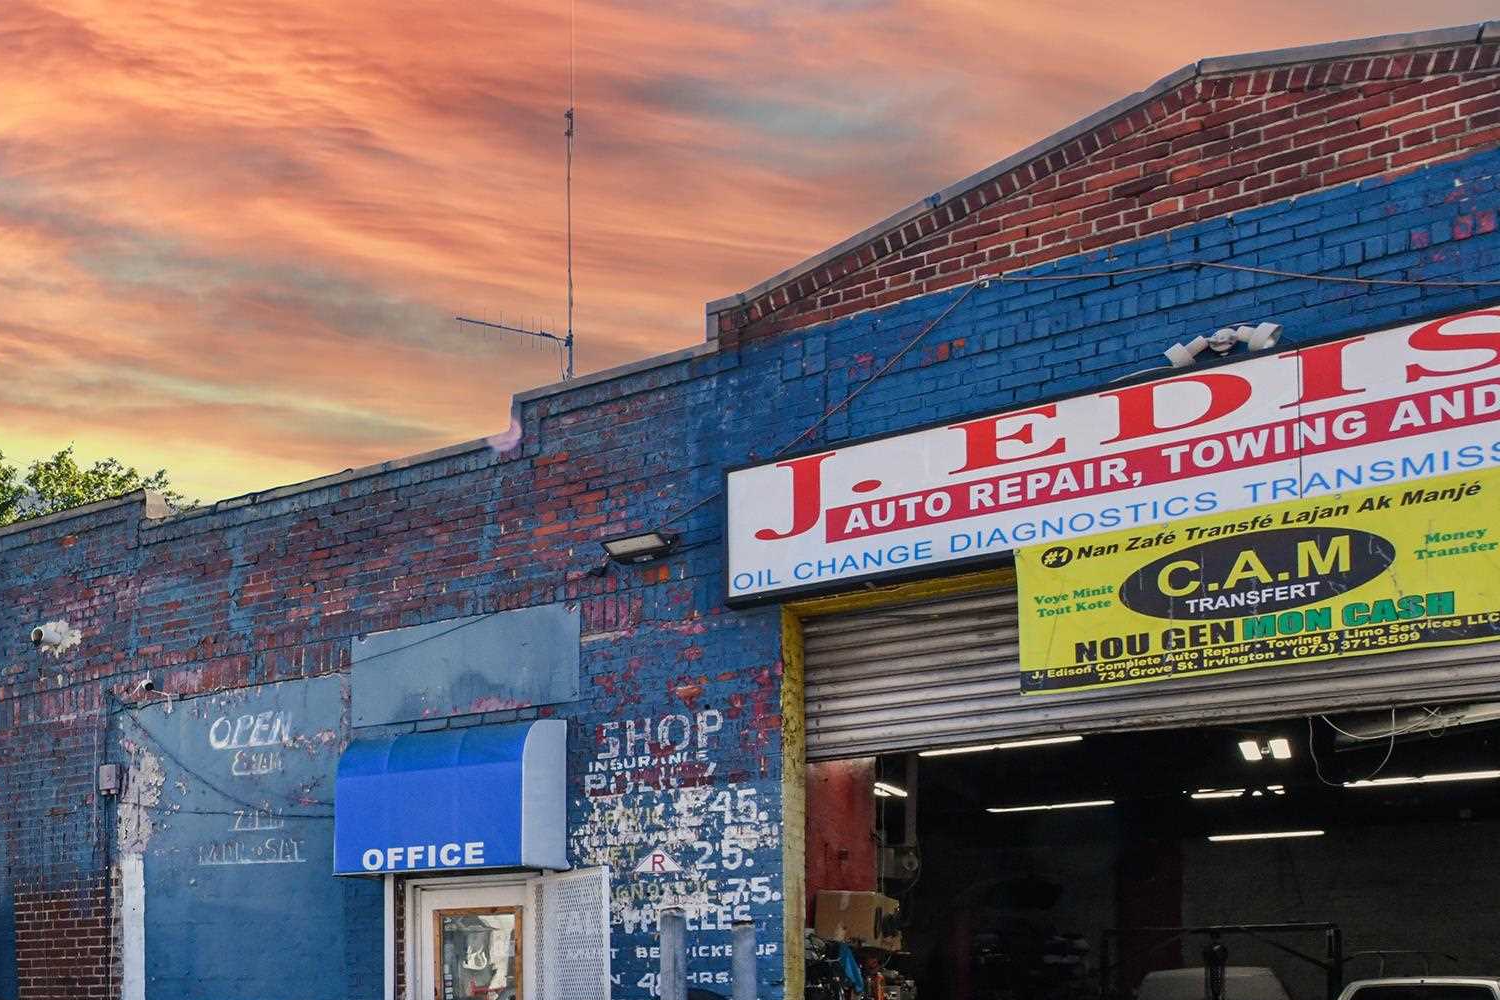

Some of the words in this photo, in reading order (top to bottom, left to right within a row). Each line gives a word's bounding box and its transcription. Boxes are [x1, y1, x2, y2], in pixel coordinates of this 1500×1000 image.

[844, 491, 952, 534] AUTO
[969, 457, 1142, 511] REPAIR,
[1162, 411, 1367, 474] TOWING
[1389, 381, 1500, 432] AND
[1077, 543, 1118, 560] Nan
[1124, 531, 1176, 550] Zafé
[1185, 512, 1273, 541] Transfé
[1281, 503, 1349, 524] Lajan
[1357, 496, 1393, 513] Ak
[1399, 480, 1482, 506] Manjé
[1426, 528, 1488, 545] Money
[733, 568, 781, 590] OIL
[794, 540, 933, 581] CHANGE
[950, 491, 1218, 553] DIAGNOSTICS
[1414, 541, 1499, 560] Transfer
[1157, 534, 1351, 597] C.A.M
[1034, 593, 1069, 606] Voye
[1073, 584, 1114, 598] Minit
[1037, 606, 1071, 618] Tout
[1076, 599, 1112, 613] Kote
[1185, 581, 1321, 613] TRANSFERT
[1075, 633, 1149, 663] NOU
[1161, 621, 1235, 650] GEN
[1243, 606, 1332, 640] MON
[1341, 591, 1455, 627] CASH
[1047, 665, 1091, 679] Edison
[1096, 655, 1161, 672] Complete
[1166, 650, 1198, 664] Auto
[1203, 644, 1251, 659] Repair
[1267, 634, 1322, 650] Towing
[1330, 631, 1340, 641] &
[1344, 626, 1384, 639] Limo
[1389, 618, 1461, 633] Services
[1098, 671, 1125, 682] 734
[1130, 665, 1173, 678] Grove
[1177, 661, 1198, 671] St.
[1203, 650, 1275, 668] Irvington
[1292, 642, 1336, 658] (973)
[1341, 632, 1421, 651] 371-5599
[209, 711, 292, 749] OPEN
[596, 709, 724, 759] SHOP
[584, 762, 717, 798] POLI
[362, 841, 485, 871] OFFICE
[652, 854, 665, 872] R
[685, 945, 733, 958] ICKE
